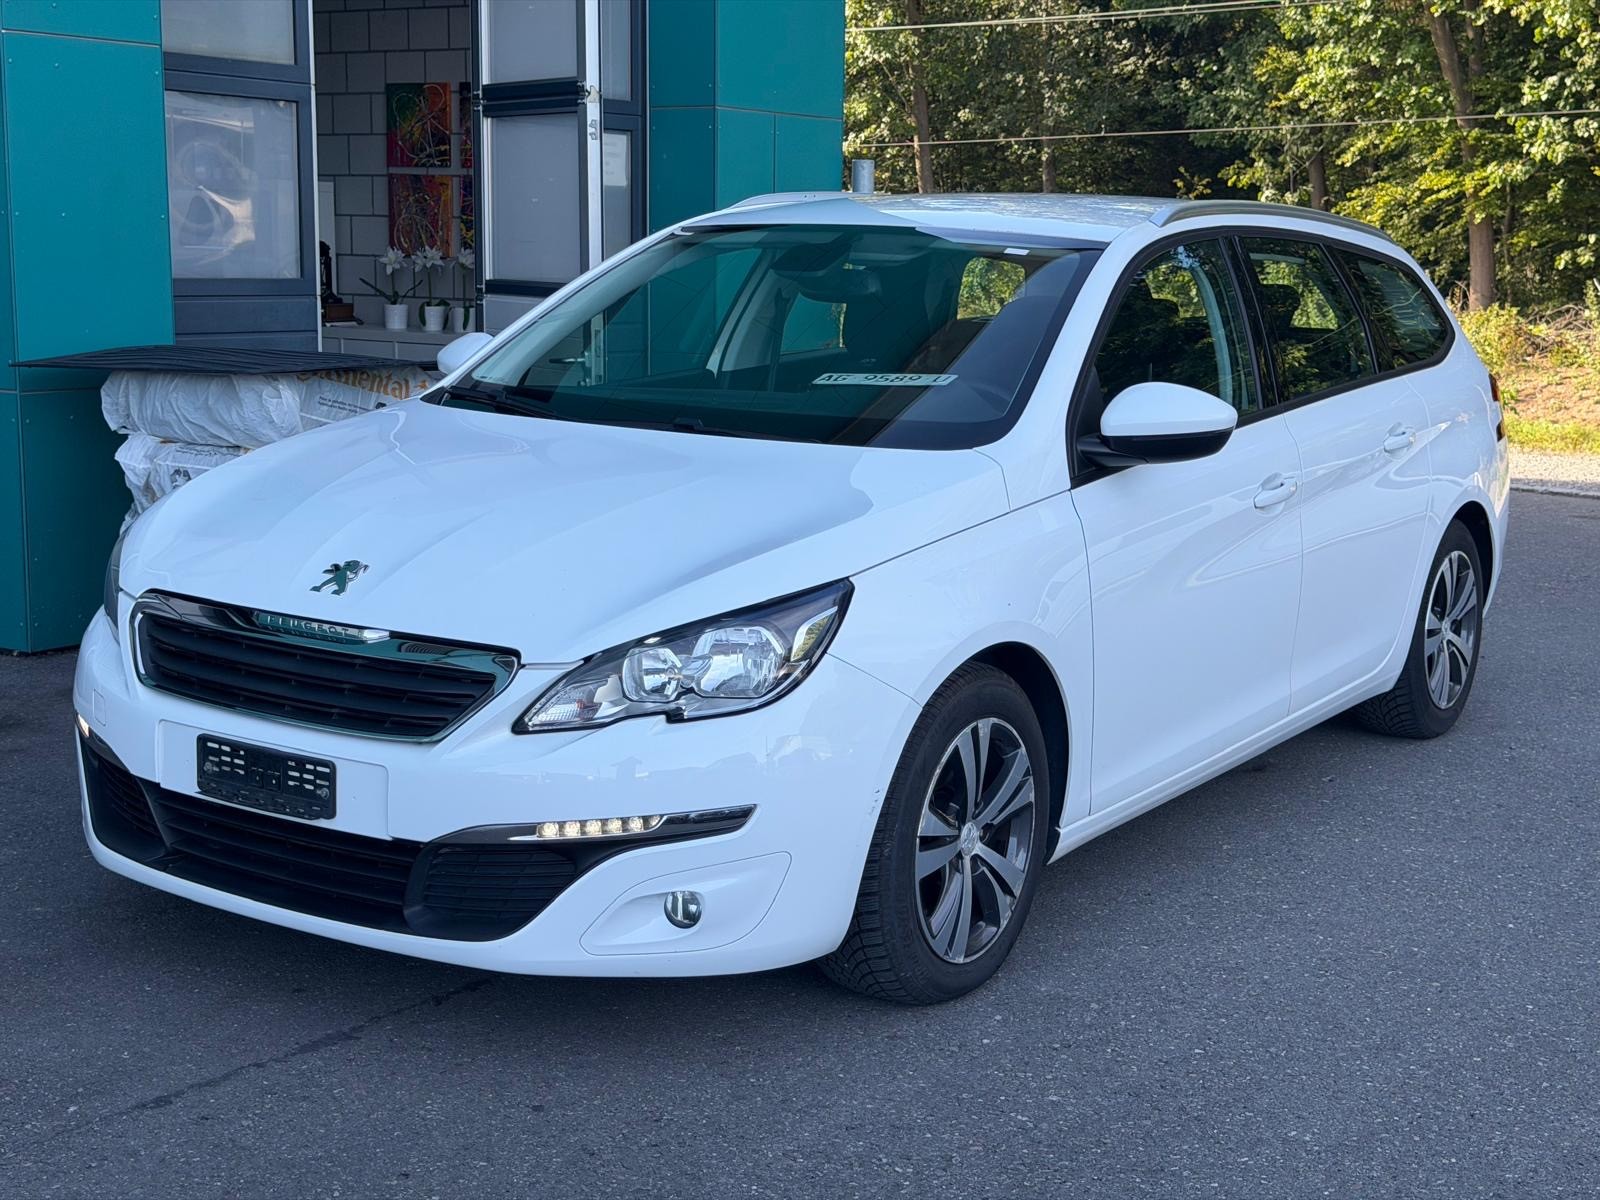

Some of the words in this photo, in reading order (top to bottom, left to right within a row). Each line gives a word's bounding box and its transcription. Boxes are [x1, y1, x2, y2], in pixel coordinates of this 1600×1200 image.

[819, 374, 851, 383] AG
[864, 374, 922, 383] 9589
[931, 375, 952, 383] U
[267, 615, 349, 637] PEUGEOT
